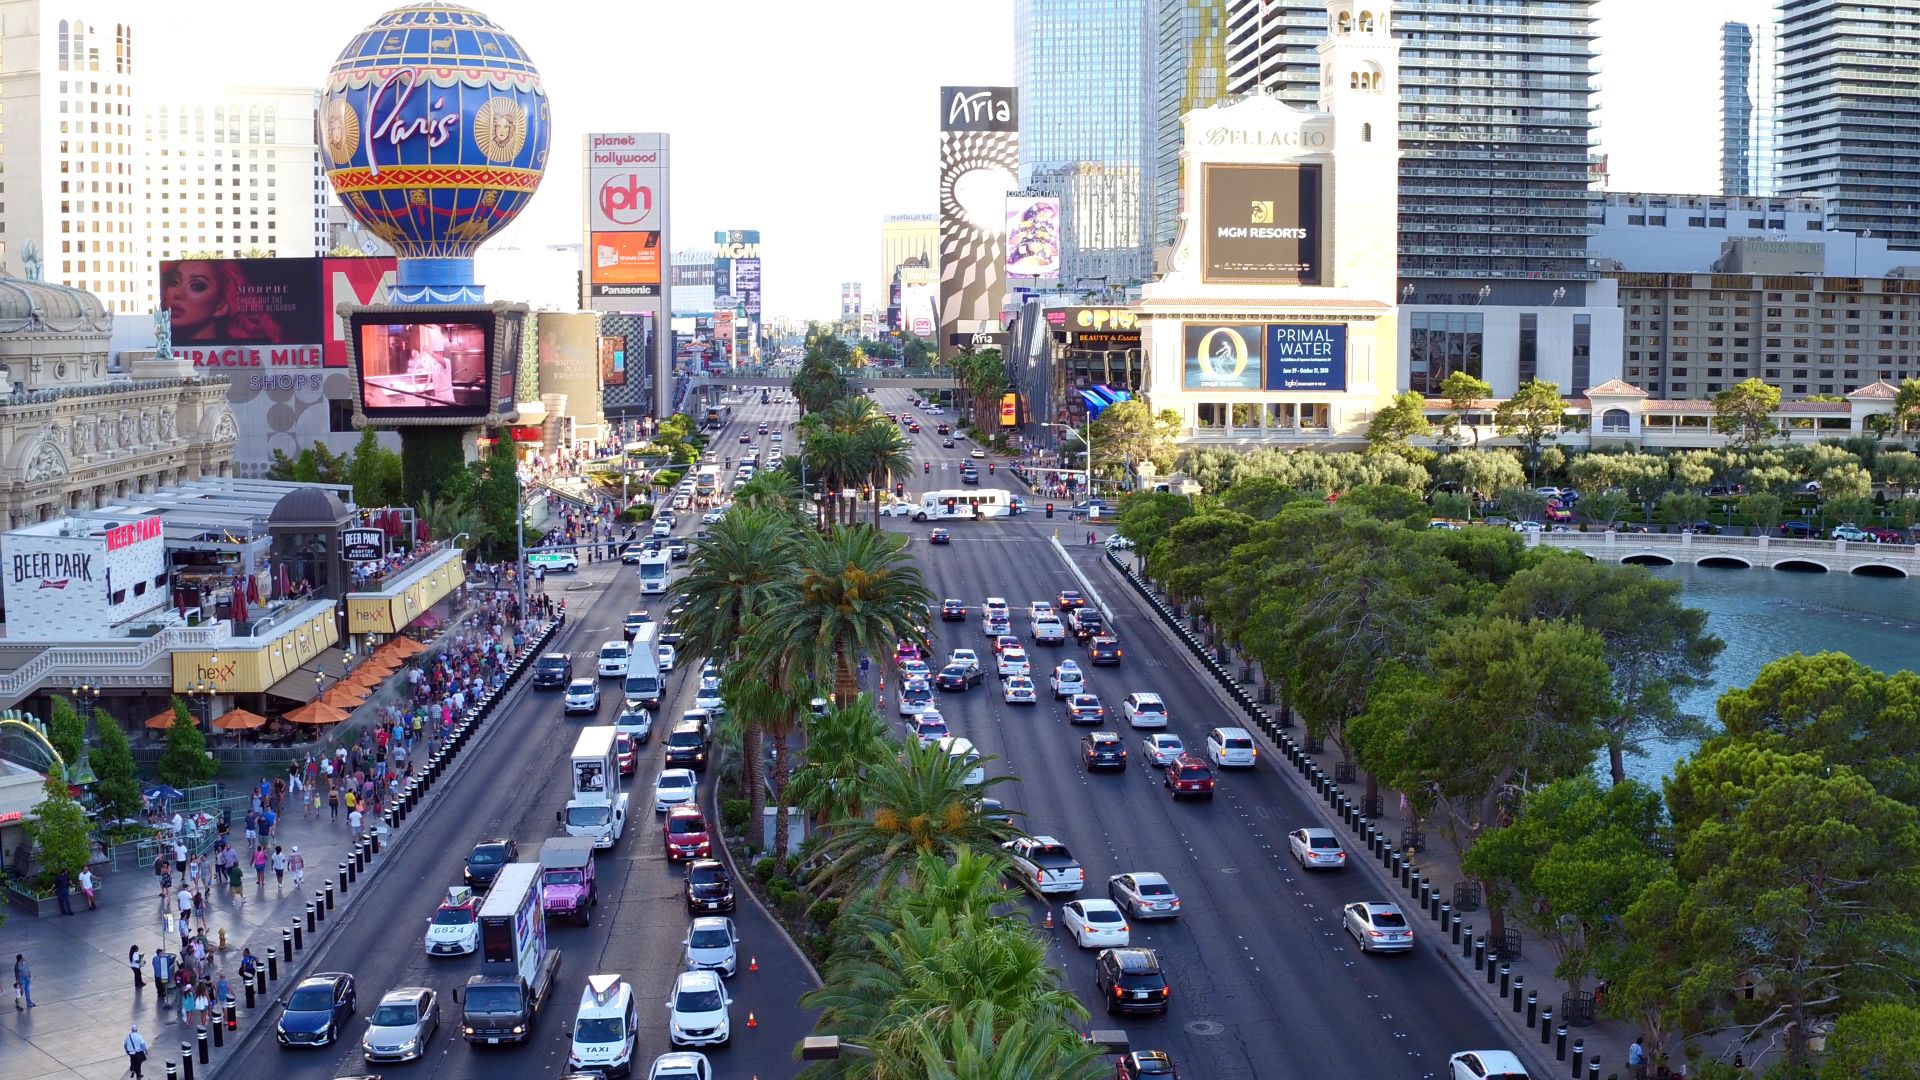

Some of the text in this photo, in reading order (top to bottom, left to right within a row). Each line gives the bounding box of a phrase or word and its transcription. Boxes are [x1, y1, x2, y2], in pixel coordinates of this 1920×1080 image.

[949, 91, 1010, 124] Aria
[365, 66, 459, 176] Paris
[594, 135, 635, 148] planet
[1199, 127, 1326, 146] BELLAGIO
[594, 152, 657, 165] hollywood
[606, 174, 652, 219] ph
[1218, 227, 1307, 239] MGM RESORTS
[713, 242, 760, 259] MGM
[237, 285, 289, 294] MORPHE
[601, 285, 651, 295] Panasonic
[972, 334, 992, 344] Aria
[1277, 328, 1334, 342] PRIMAL
[1280, 342, 1332, 356] WATER
[271, 348, 320, 366] MILE
[250, 374, 322, 391] SHOPS
[106, 515, 162, 553] BEER PARK
[344, 533, 380, 547] BEER PARK
[14, 552, 92, 583] BEER PARK
[356, 607, 385, 622] hexx
[198, 660, 237, 682] hexx
[434, 926, 464, 934] 6824
